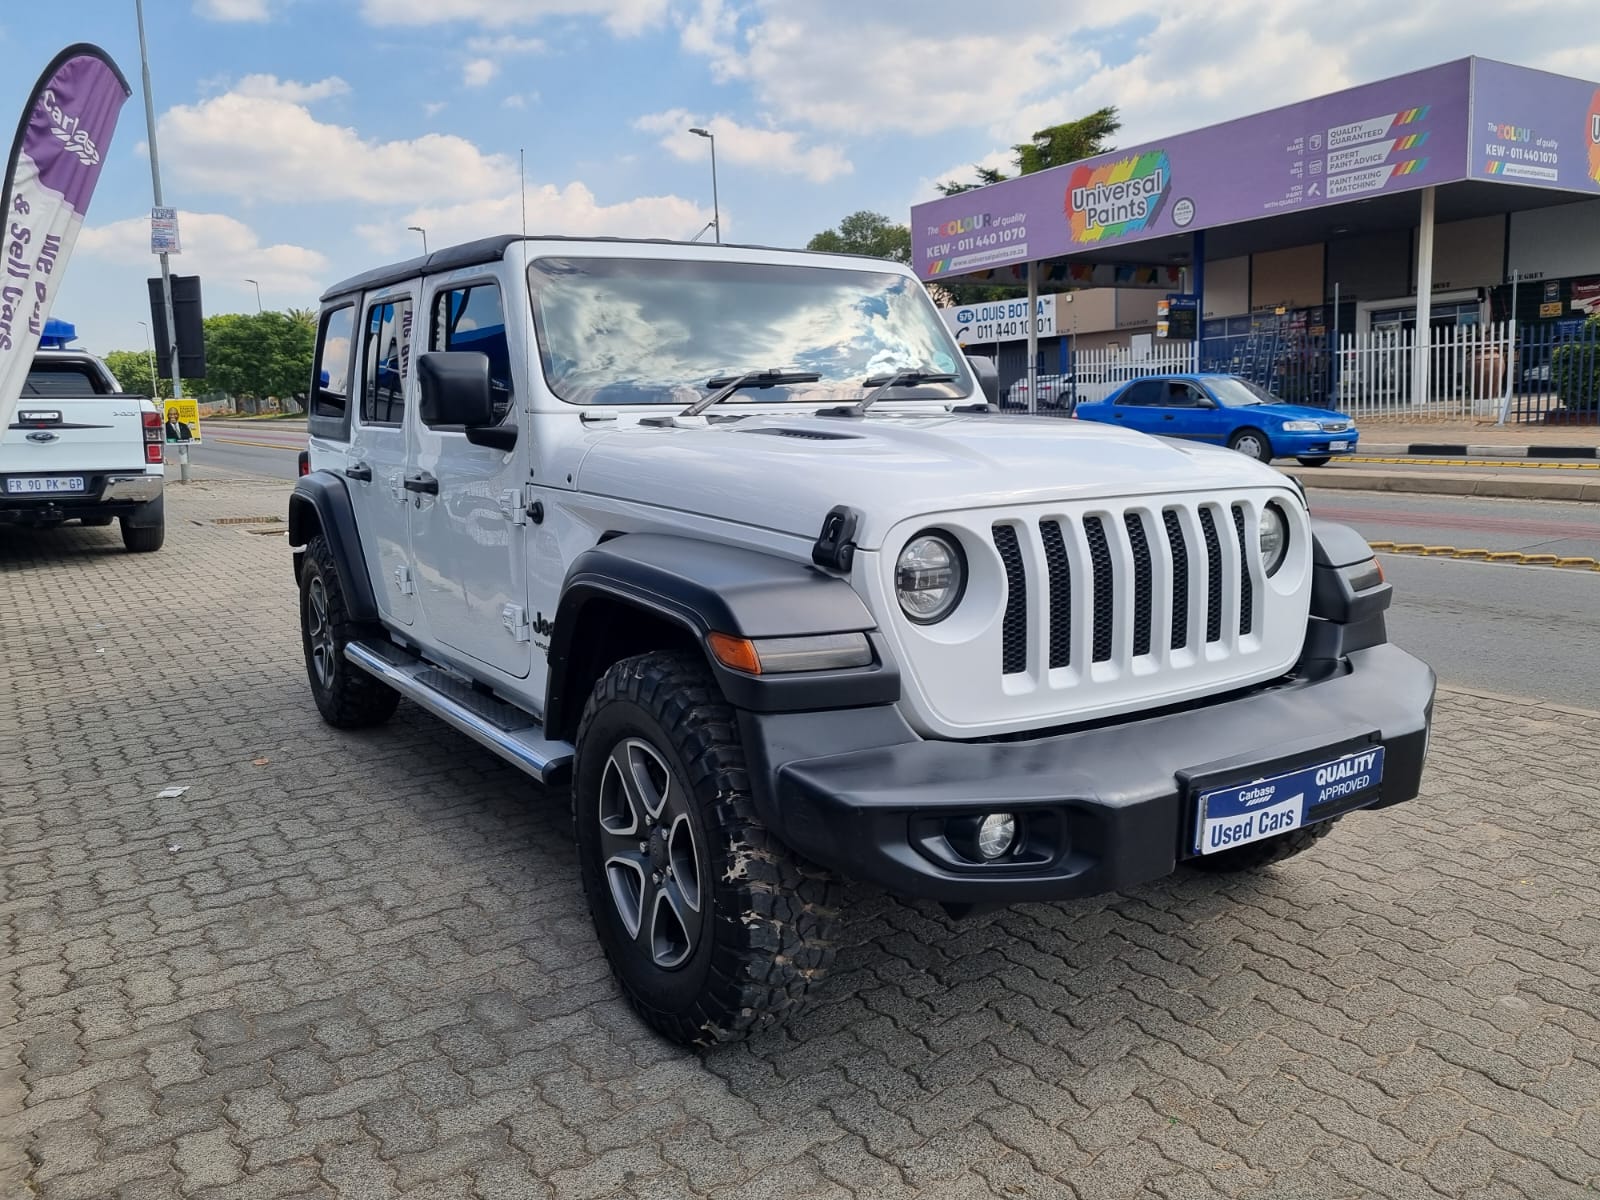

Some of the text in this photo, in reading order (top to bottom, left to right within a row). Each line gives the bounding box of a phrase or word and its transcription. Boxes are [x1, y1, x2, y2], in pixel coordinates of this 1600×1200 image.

[43, 90, 99, 162] Caras
[1330, 125, 1363, 138] QUALITY
[1488, 122, 1497, 132] The
[1330, 128, 1383, 146] GUARANTEED
[1329, 150, 1359, 162] EXPERT
[1329, 153, 1383, 170] PAINT ADVICE
[1486, 143, 1505, 157] KEW
[1510, 147, 1522, 159] 011
[1523, 149, 1539, 162] 440
[1539, 151, 1557, 164] 1070
[1329, 170, 1382, 186] PAINT MIXING
[1335, 180, 1376, 193] MATCHING
[1073, 169, 1161, 210] Universal
[14, 193, 31, 215] &
[1087, 199, 1146, 227] Paints
[928, 213, 1026, 237] The COLOUR of quality
[7, 222, 31, 279] Sell
[927, 243, 950, 258] KEW
[958, 238, 974, 250] 011
[976, 233, 997, 246] 440
[999, 227, 1026, 242] 1070
[36, 234, 61, 275] We
[975, 305, 1005, 322] LOUIS
[1008, 301, 1044, 319] BOTA
[977, 324, 993, 339] 011
[996, 322, 1016, 336] 440
[9, 479, 82, 490] FR 90 PK GP
[533, 611, 555, 637] Je
[1315, 752, 1376, 786] QUALITY
[1238, 785, 1276, 802] Carbase
[1318, 775, 1370, 802] APPROVED
[1211, 809, 1294, 848] Used Cars
